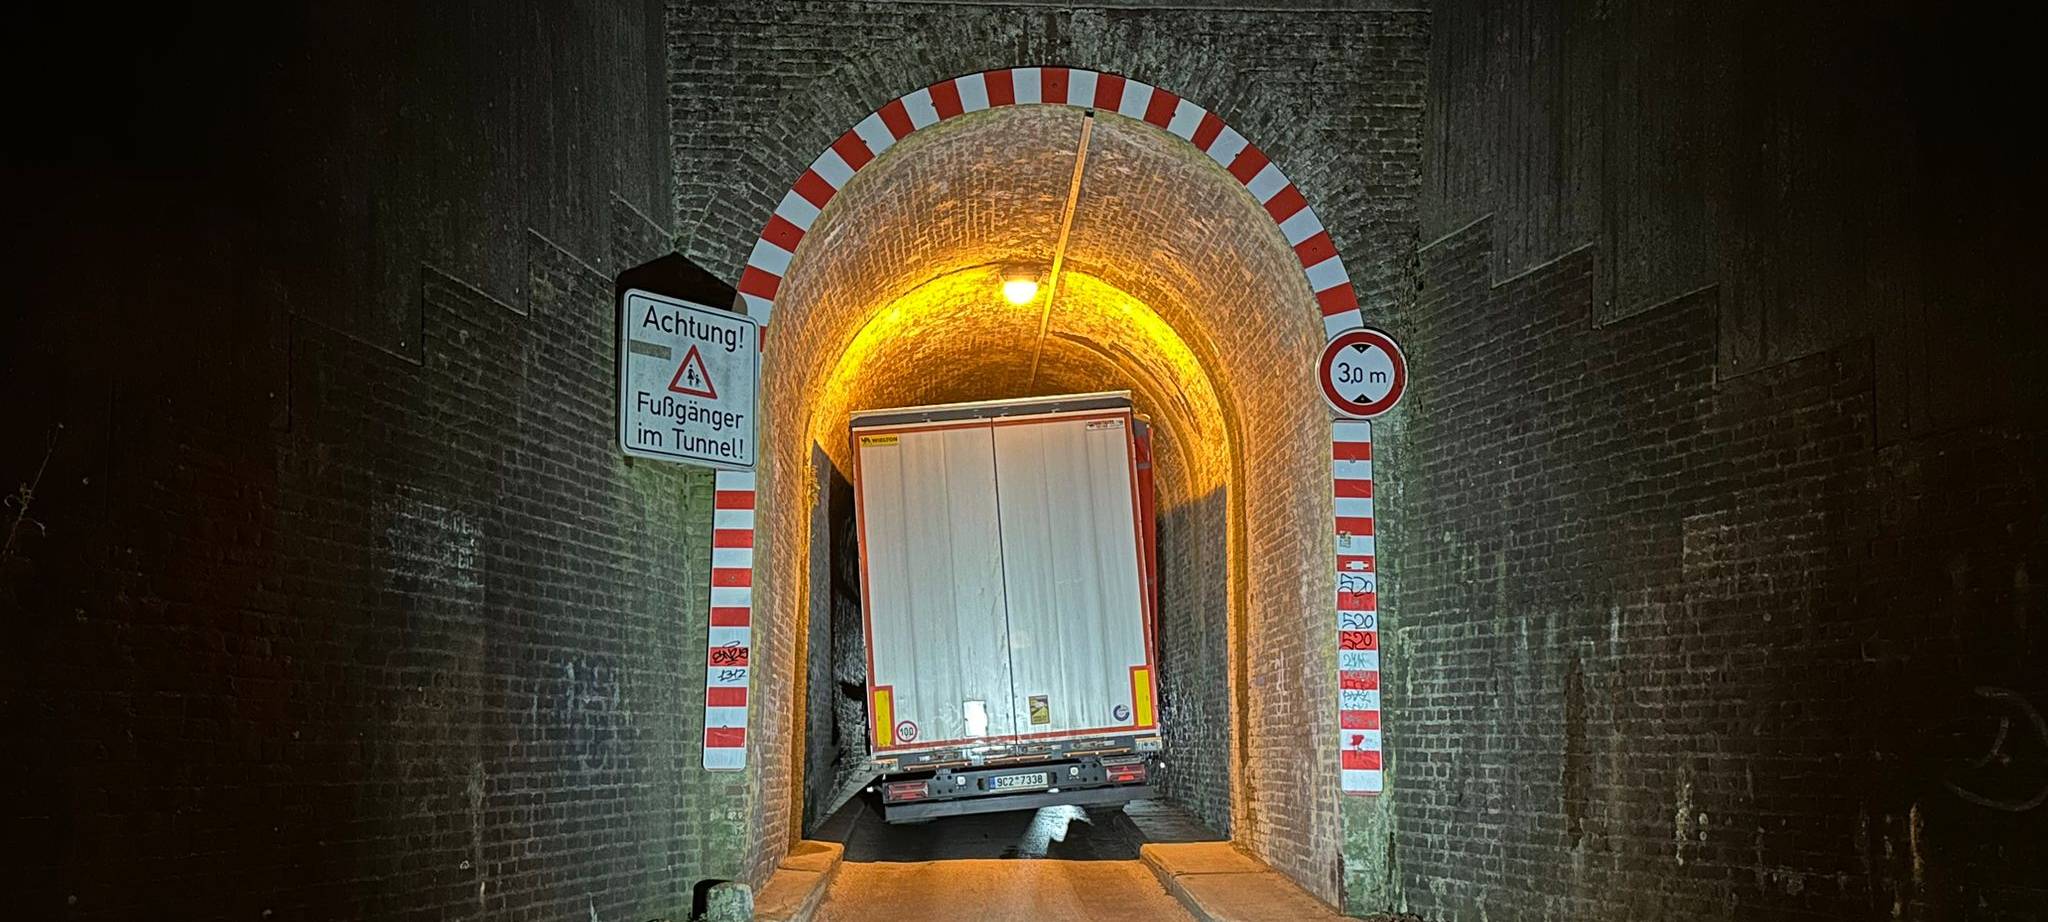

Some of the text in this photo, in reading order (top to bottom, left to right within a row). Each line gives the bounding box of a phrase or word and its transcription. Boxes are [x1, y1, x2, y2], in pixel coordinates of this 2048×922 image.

[643, 305, 744, 352] Achtung!
[1338, 362, 1386, 384] 3,0 m
[637, 391, 744, 430] Fußgänger
[638, 423, 743, 459] im Tunnel!
[1342, 612, 1374, 629] 520
[1339, 631, 1373, 651] 520
[718, 669, 746, 681] 1312
[899, 727, 914, 737] 100
